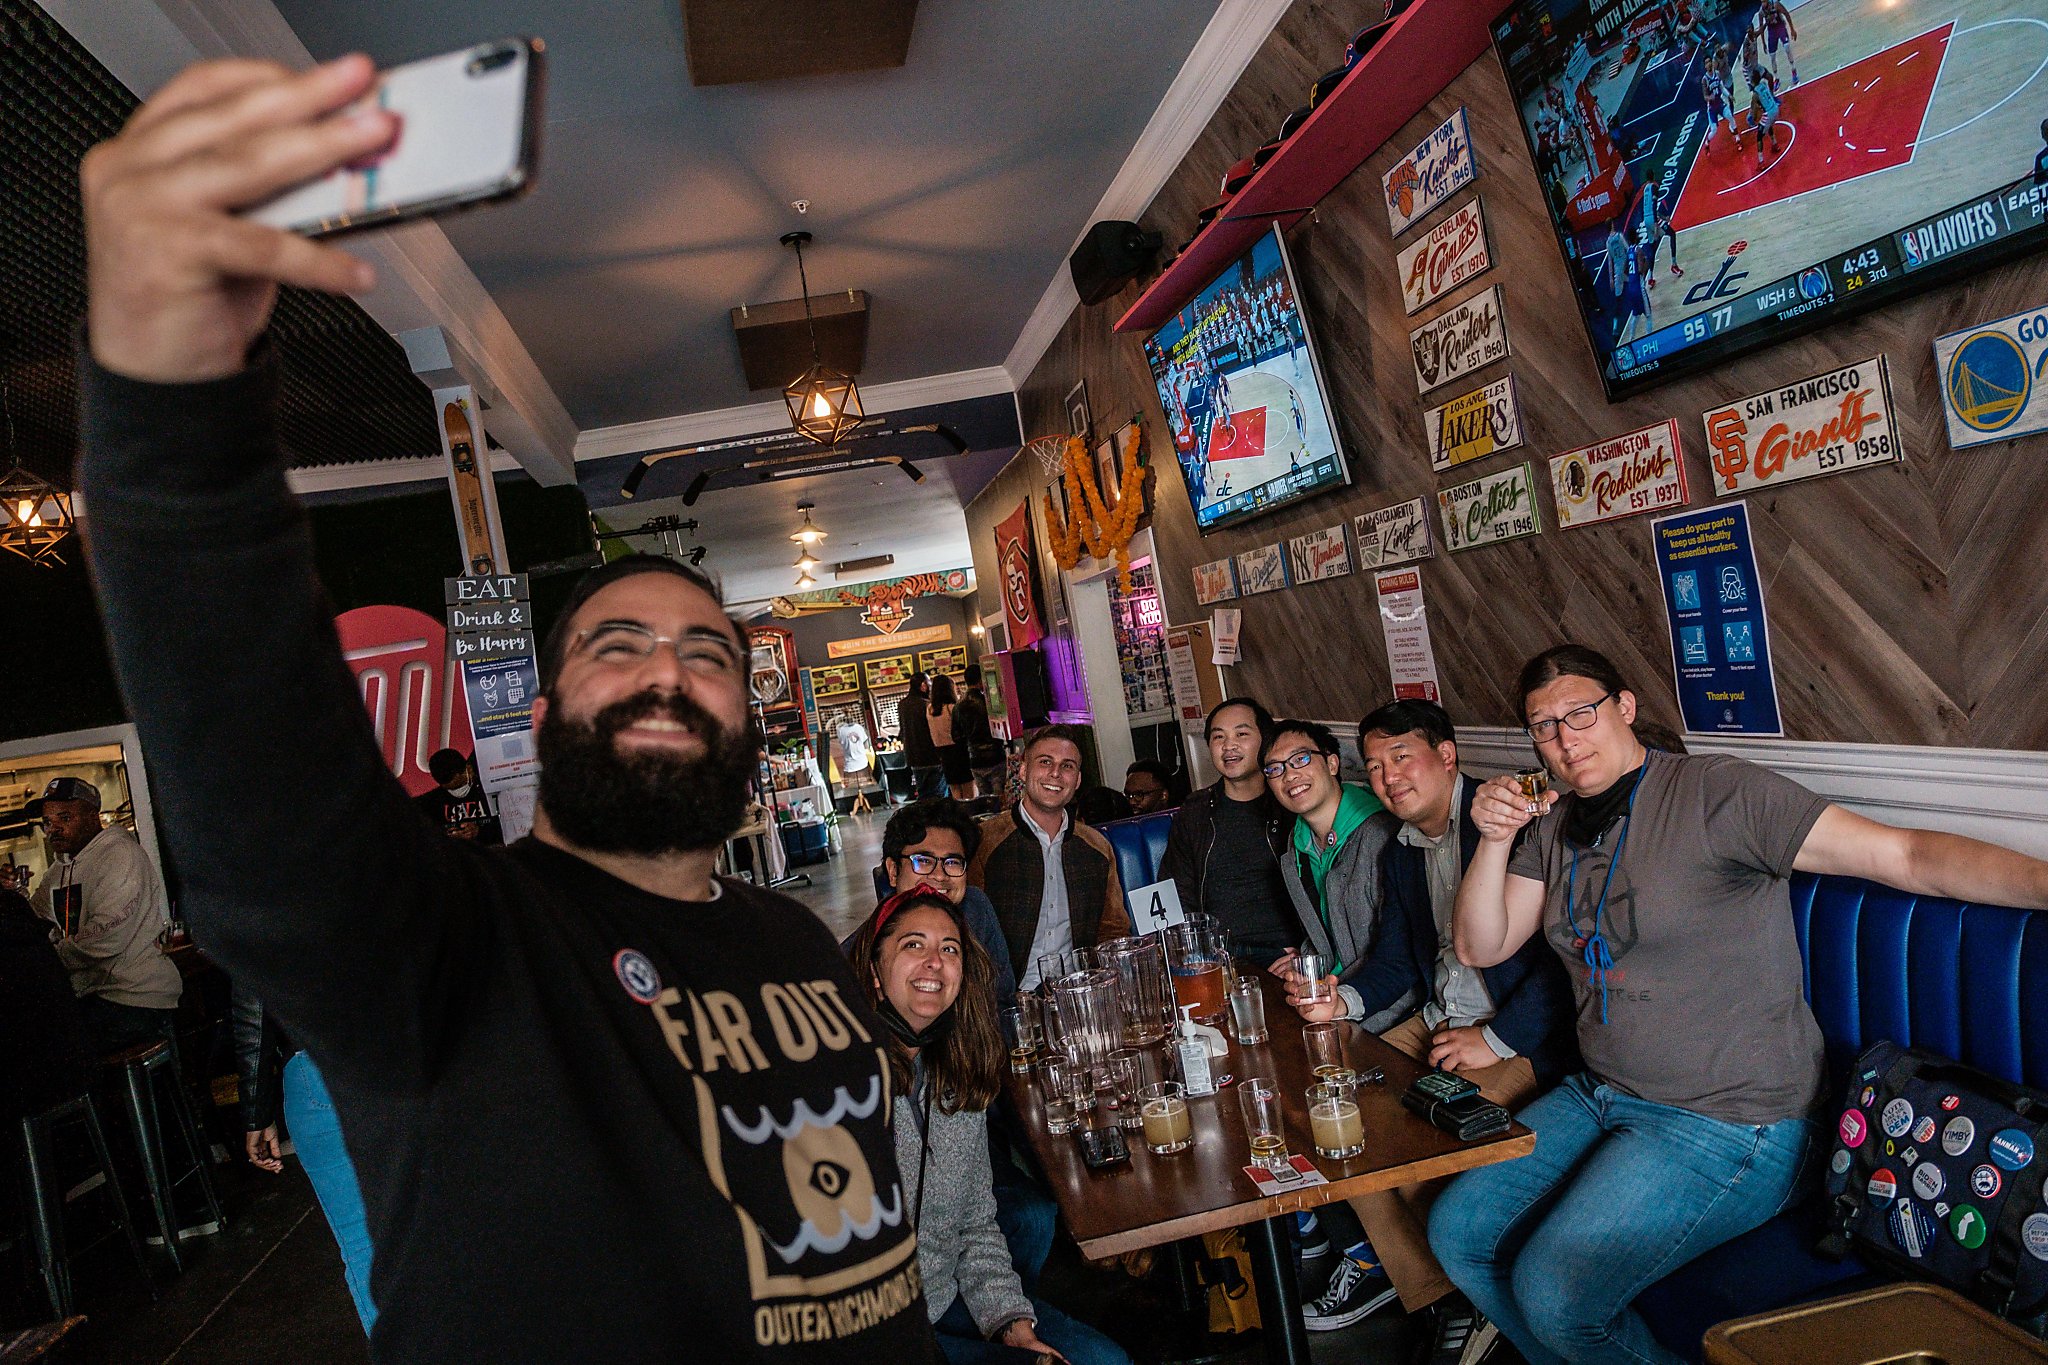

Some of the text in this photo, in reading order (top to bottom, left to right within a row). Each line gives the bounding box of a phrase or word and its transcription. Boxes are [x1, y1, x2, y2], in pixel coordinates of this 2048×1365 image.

[1595, 6, 1622, 38] WITH
[1415, 119, 1455, 163] NEW YORK
[1664, 111, 1699, 167] Arena
[1418, 138, 1466, 204] Knicks
[1436, 163, 1470, 199] EST 1946
[1431, 209, 1469, 244] CLEVELAND
[1918, 201, 1997, 261] PLAYOFFS
[1451, 252, 1485, 283] EST 1970
[1843, 248, 1880, 274] 4:43
[1846, 266, 1888, 291] 24 3rd
[1438, 307, 1470, 333] OAKLAND
[1642, 340, 1659, 357] PHI
[1684, 318, 1706, 342] 95
[1712, 306, 1733, 331] 77
[1757, 288, 1786, 311] WSH
[1788, 288, 1796, 299] 8
[1441, 303, 1497, 377] Raiders
[1467, 340, 1502, 369] EST 1960
[1450, 383, 1506, 414] LOS ANGELES
[1746, 369, 1861, 421] SAN FRANCISCO
[1434, 398, 1515, 464] LAKERS
[1753, 388, 1882, 481] Giants
[1587, 432, 1651, 465] WASHINGTON
[1817, 435, 1890, 470] EST 1958
[1453, 481, 1483, 502] BOSTON
[1592, 445, 1671, 515] Redskins
[1225, 501, 1231, 511] 77
[1629, 482, 1678, 509] EST 1937
[1375, 503, 1414, 524] SACRAMENTO
[1466, 476, 1525, 542] Celtics
[1305, 530, 1328, 545] NEW YORK
[1382, 515, 1422, 563] Kings
[1494, 516, 1532, 538] EST 1946
[1662, 517, 1735, 538] Please do your part to
[1670, 538, 1687, 548] keep
[1705, 530, 1731, 541] healthy
[1359, 534, 1379, 548] KINGS
[1407, 549, 1416, 558] EST
[1678, 546, 1707, 559] essential
[1708, 542, 1738, 554] workers.
[1310, 536, 1344, 578] Yankees
[1326, 565, 1335, 576] EST
[1398, 574, 1415, 585] RULES
[457, 577, 517, 600] EAT
[454, 608, 523, 628] Drink &
[456, 636, 527, 655] Be Happy
[842, 641, 861, 649] JOIN
[862, 638, 877, 646] THE
[1706, 691, 1745, 702] Thank you!
[1149, 890, 1166, 920] 4
[652, 979, 872, 1074] FAR OUT
[1883, 1100, 1904, 1117] VOTE
[1888, 1116, 1910, 1133] DEM
[1944, 1130, 1971, 1141] YIMBY
[1915, 1175, 1935, 1193] HARRIS
[1918, 1169, 1938, 1188] BIDEN
[754, 1282, 912, 1347] OUTER RICHMOND
